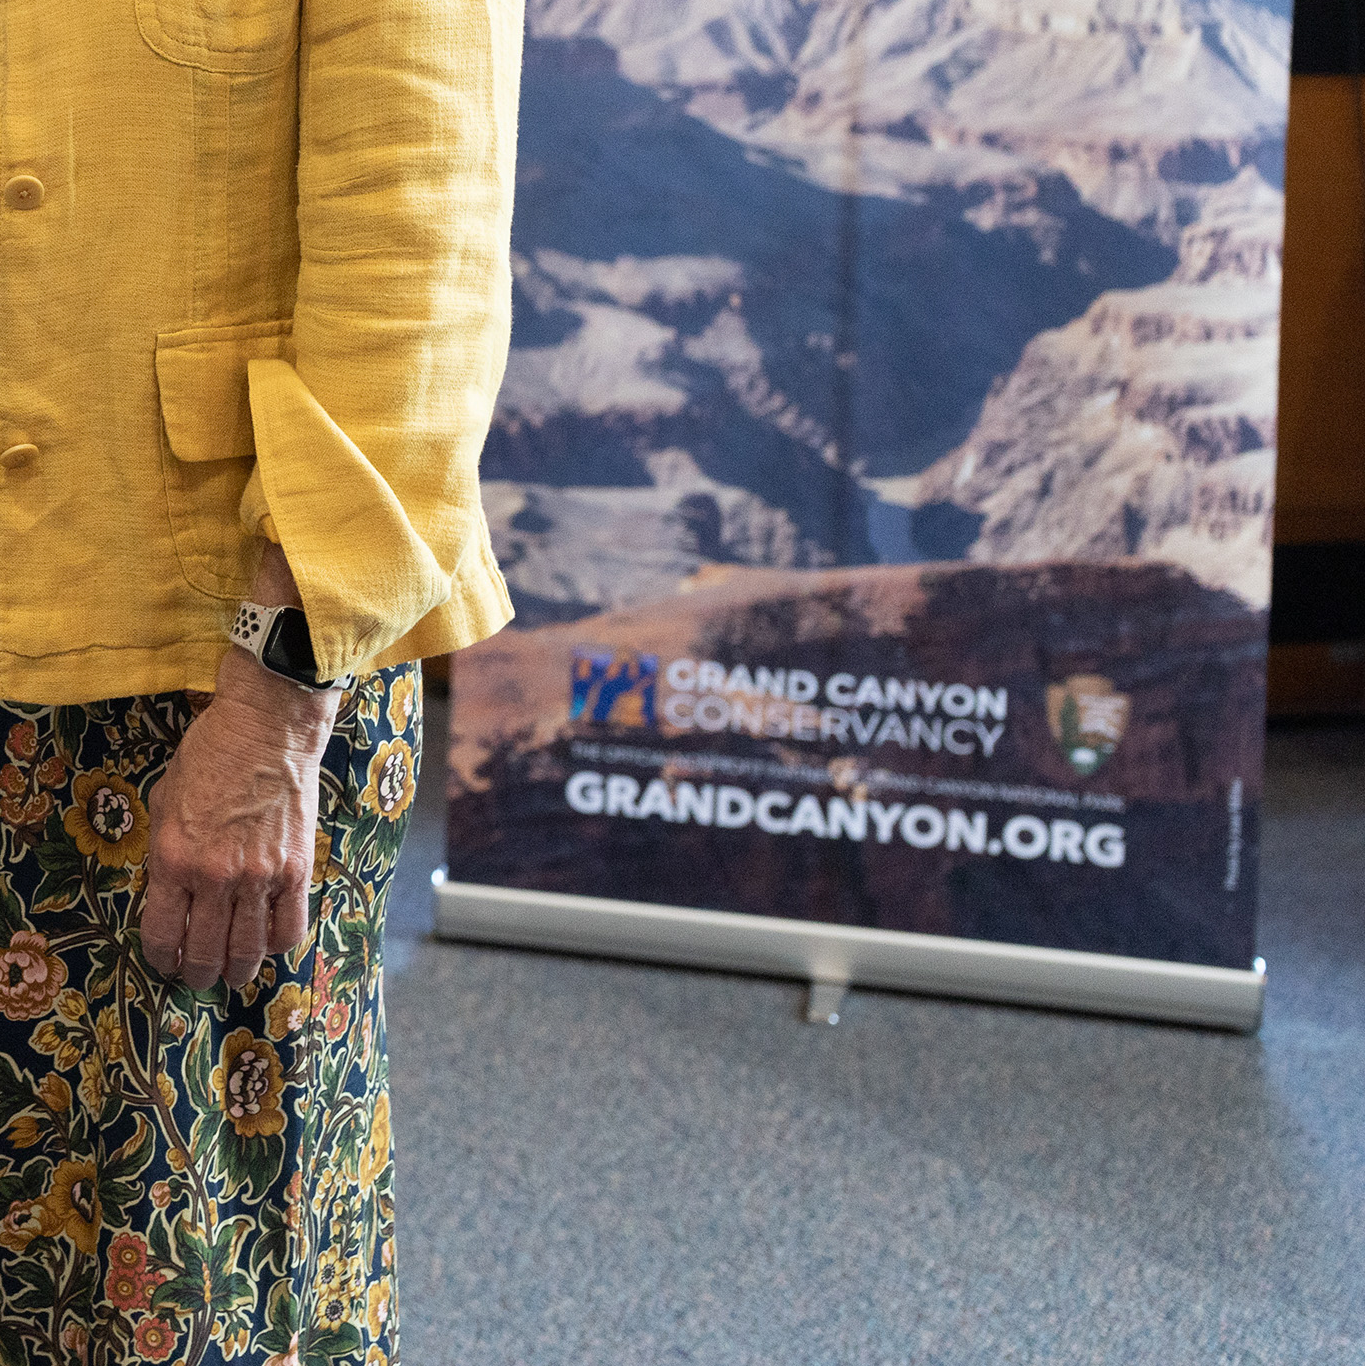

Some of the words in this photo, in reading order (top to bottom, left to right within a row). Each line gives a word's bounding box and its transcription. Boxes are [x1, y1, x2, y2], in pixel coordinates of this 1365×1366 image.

[667, 656, 814, 704] GRAND
[825, 673, 1008, 721] CANYON
[667, 695, 1006, 758] CONSERVANCY
[565, 770, 1127, 869] GRANDCANYON.ORG
